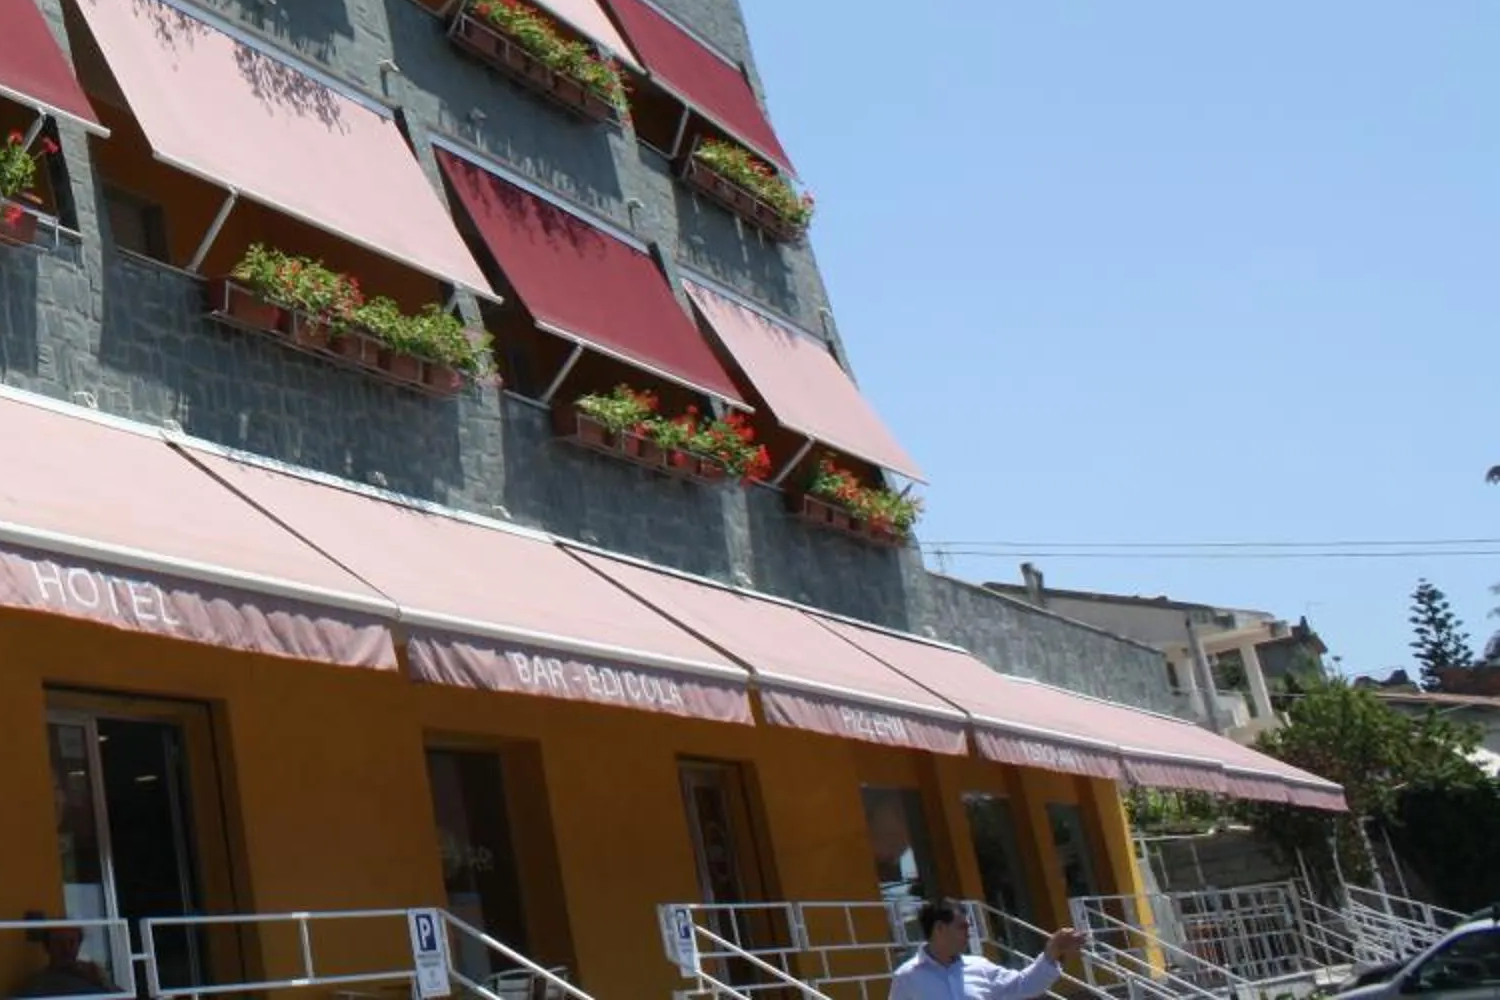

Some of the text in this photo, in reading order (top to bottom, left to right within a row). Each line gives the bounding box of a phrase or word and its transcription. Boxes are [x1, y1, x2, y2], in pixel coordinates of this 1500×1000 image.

[31, 560, 180, 626] HOTEL
[512, 652, 569, 694] BAR
[583, 664, 684, 707] EDICOLA
[418, 917, 431, 949] P
